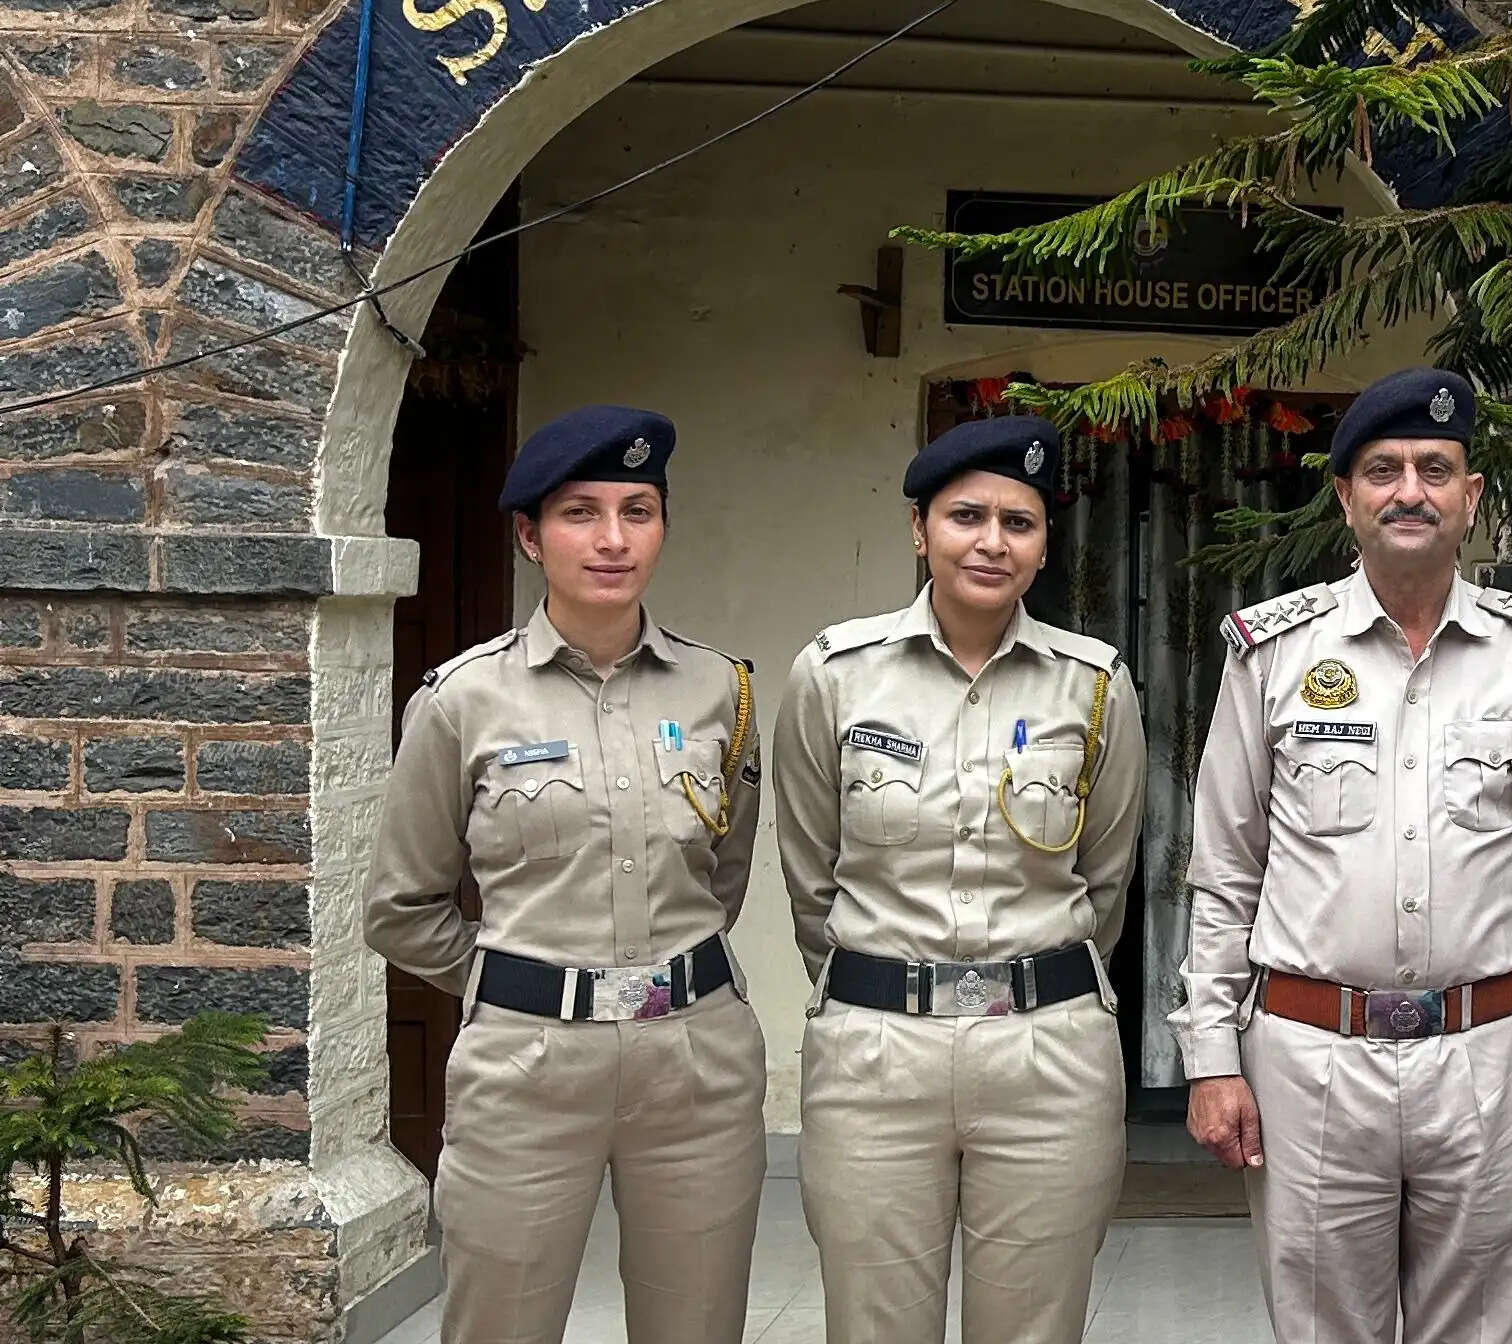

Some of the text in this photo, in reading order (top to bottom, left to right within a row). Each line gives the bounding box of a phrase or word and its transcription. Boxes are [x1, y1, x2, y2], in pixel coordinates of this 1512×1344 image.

[971, 272, 1314, 315] STATION HOUSE OFFICER
[1298, 723, 1371, 736] HEM RAJ NEGI
[854, 731, 917, 757] REKHA SHARMA
